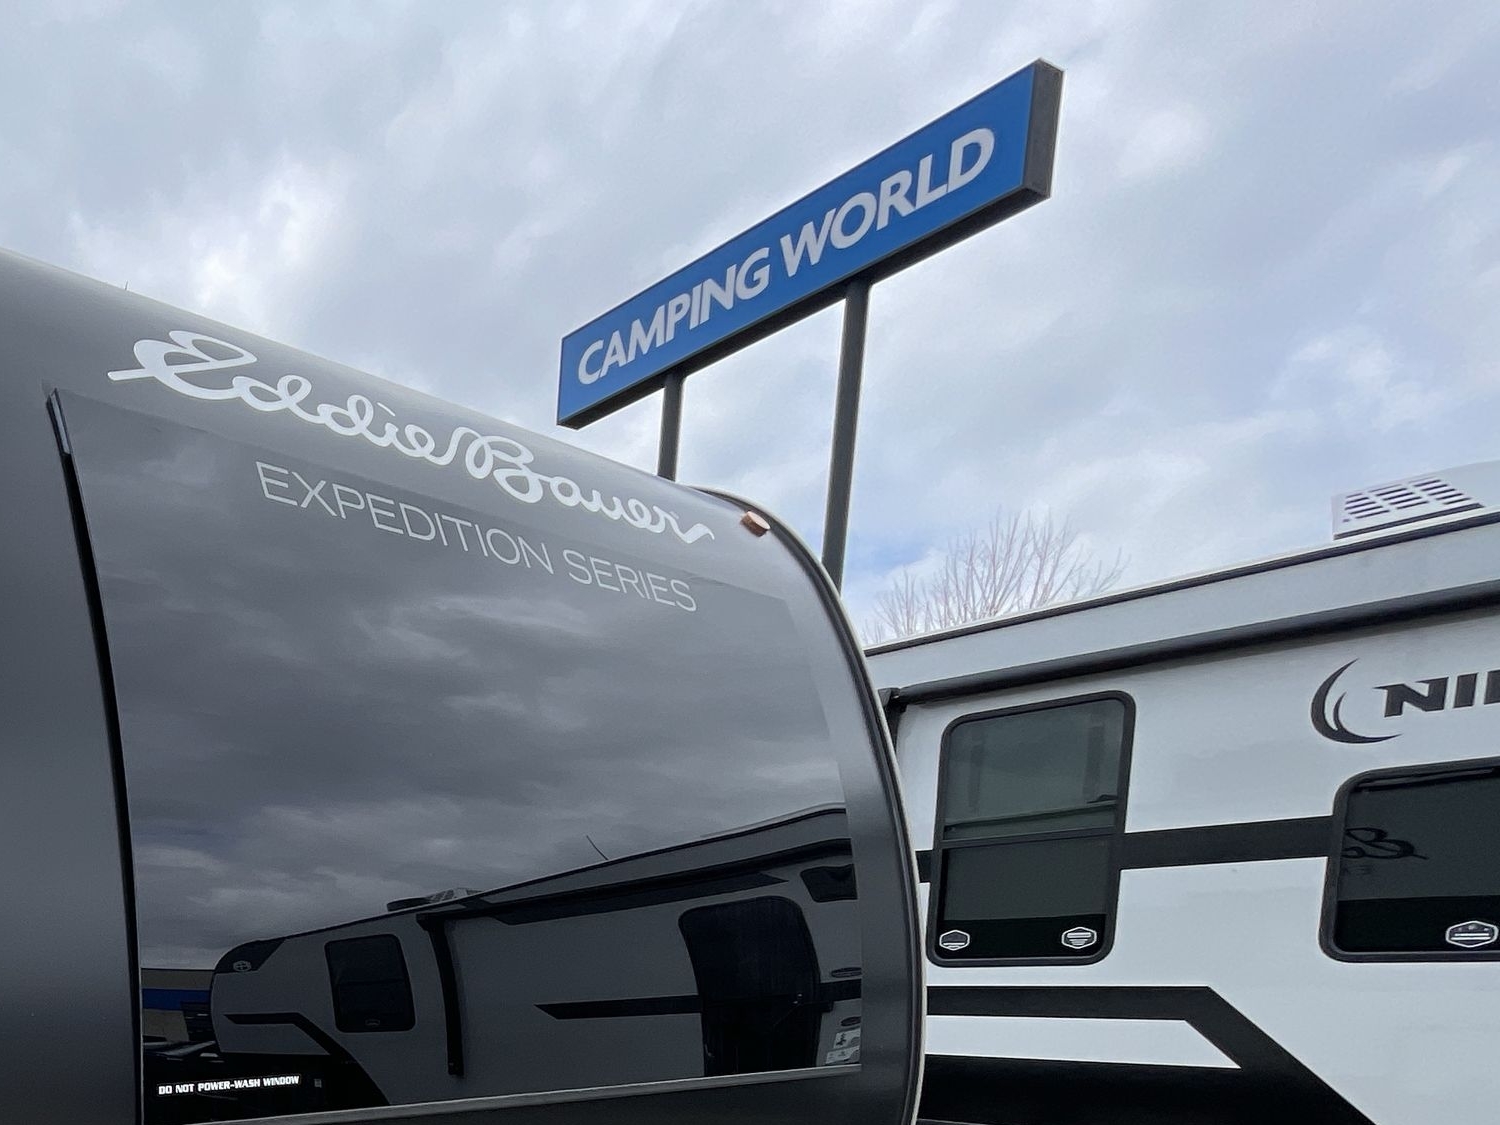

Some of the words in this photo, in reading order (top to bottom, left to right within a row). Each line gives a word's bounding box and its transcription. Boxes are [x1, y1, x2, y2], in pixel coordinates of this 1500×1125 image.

[577, 247, 771, 385] CAMPING
[780, 127, 996, 278] WORLD
[107, 330, 455, 465] Eddie
[450, 424, 715, 545] Bauer
[256, 461, 555, 575] EXPEDITION
[561, 549, 697, 613] SERIES
[1372, 669, 1500, 717] NI
[158, 1085, 173, 1095] DO
[176, 1084, 195, 1094] NOT
[198, 1078, 261, 1092] POWER-WASH
[263, 1075, 300, 1087] WINDOW
